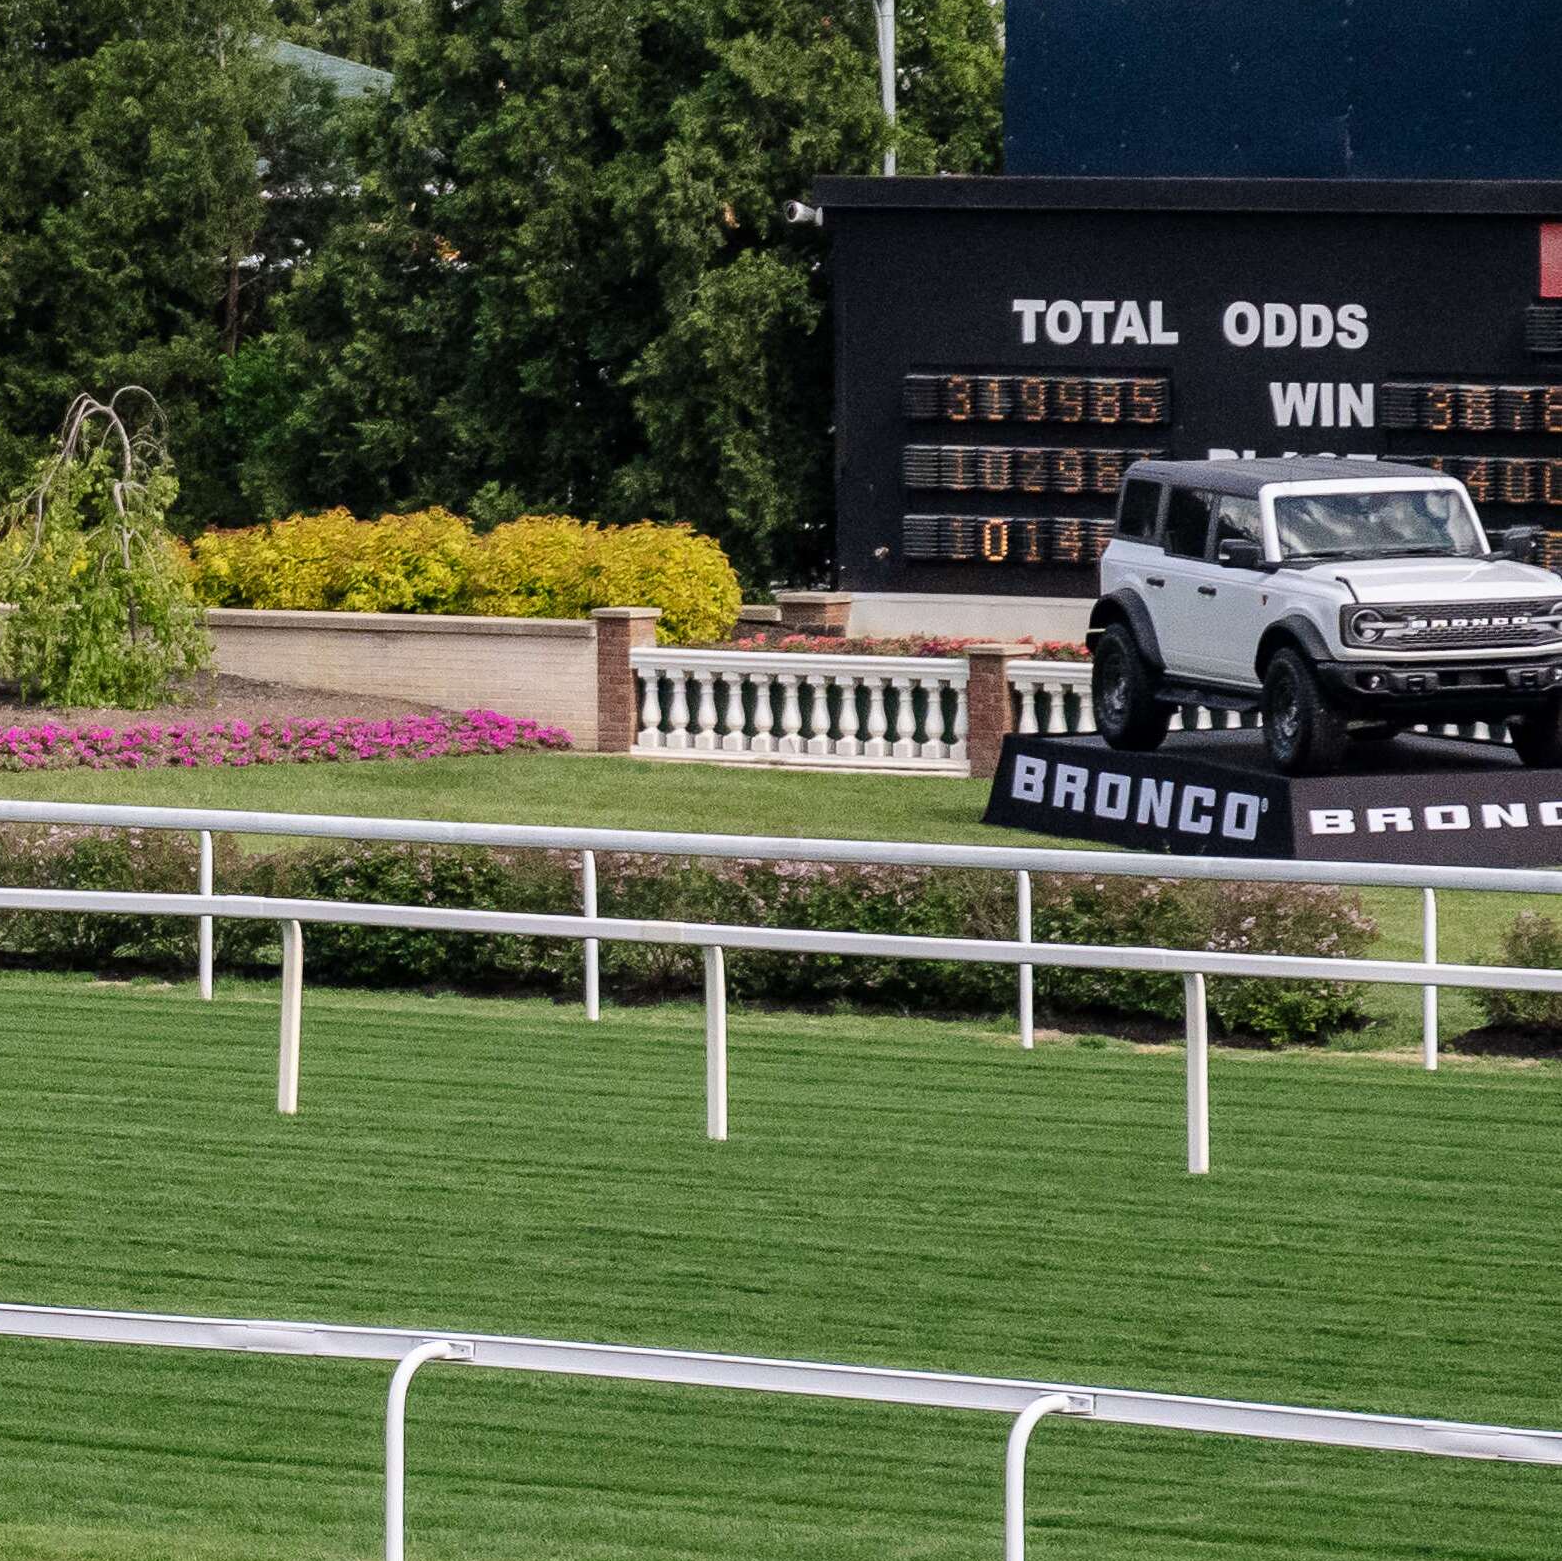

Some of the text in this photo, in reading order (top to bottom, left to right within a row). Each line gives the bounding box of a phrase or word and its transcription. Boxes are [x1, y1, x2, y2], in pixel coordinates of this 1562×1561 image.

[1012, 299, 1370, 349] TOTAL ODDS
[1269, 382, 1375, 428] WIN
[1411, 616, 1528, 629] BRONCO
[1010, 754, 1260, 841] BRONCO
